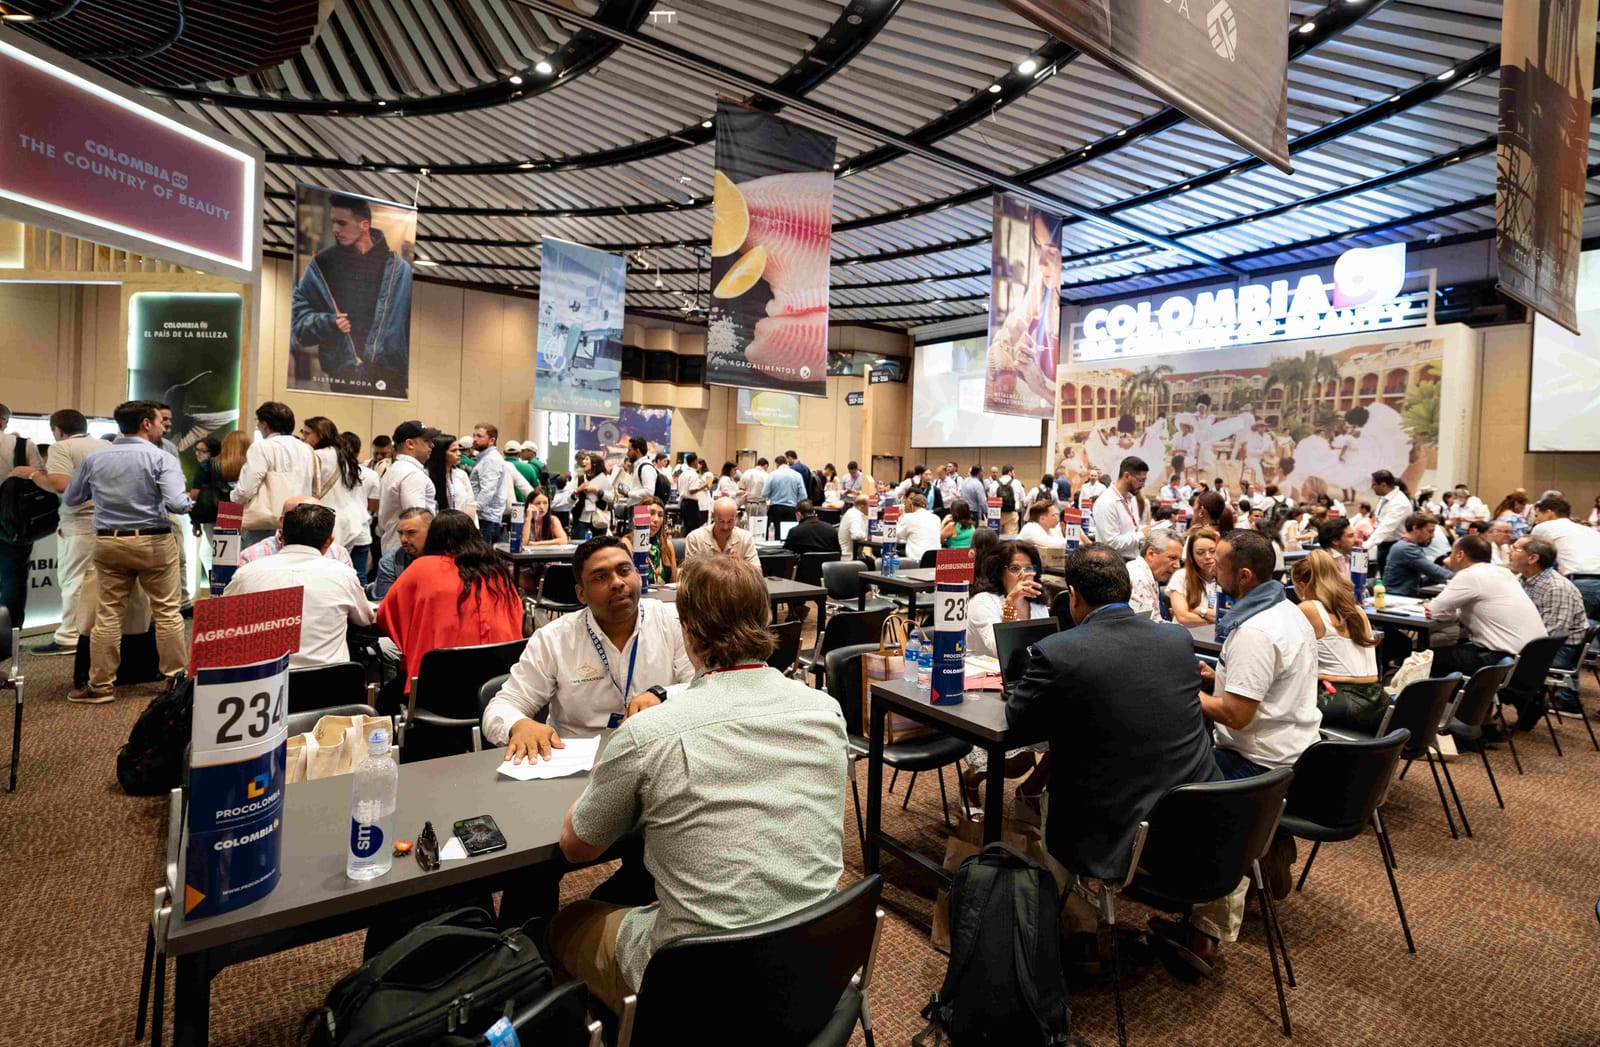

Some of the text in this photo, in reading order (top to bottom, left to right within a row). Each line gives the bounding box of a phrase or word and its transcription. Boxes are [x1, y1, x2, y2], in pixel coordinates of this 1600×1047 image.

[85, 139, 170, 183] COLOMBIA
[19, 134, 230, 221] THE COUNTRY OF BEAUTY
[1083, 274, 1331, 340] COLOMBIA
[144, 330, 152, 338] EL
[154, 329, 171, 338] PAÍS
[172, 330, 182, 338] DE
[196, 331, 228, 339] BELLEZA
[313, 376, 372, 387] SISTEMA MODA
[730, 360, 796, 375] AGROALIMENTOS
[937, 562, 975, 570] AGRIBUSINESS
[32, 576, 52, 588] LA
[194, 615, 302, 644] AGROALIMENTOS
[216, 685, 284, 744] 234
[216, 789, 280, 819] PROCOLOMBIA
[214, 824, 274, 851] COLOMBIA
